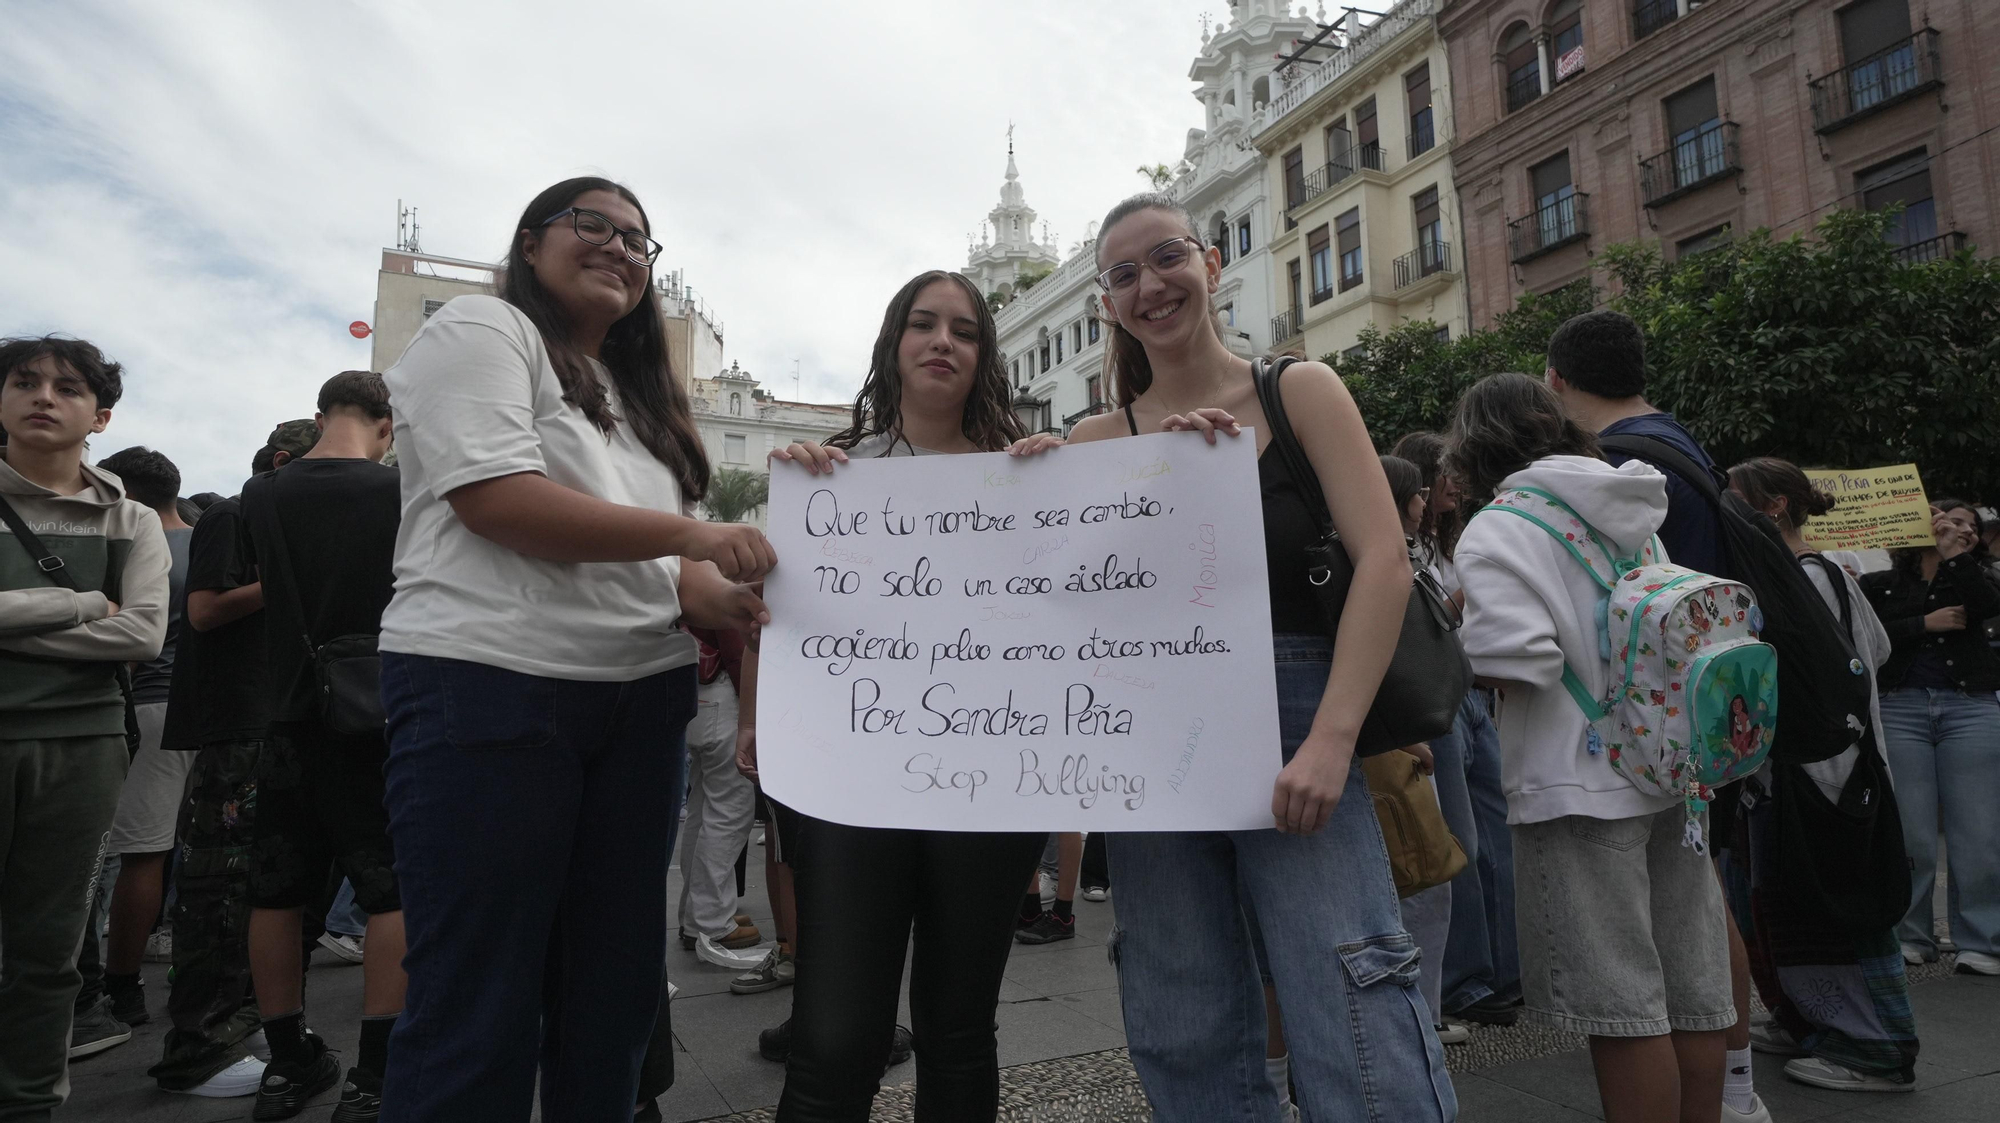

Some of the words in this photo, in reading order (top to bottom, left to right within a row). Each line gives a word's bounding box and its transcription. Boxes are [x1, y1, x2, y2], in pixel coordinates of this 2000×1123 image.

[983, 468, 1022, 489] KIRA
[1811, 477, 1837, 491] DRA
[1874, 477, 1886, 485] ES
[1887, 475, 1903, 484] UNA
[1904, 473, 1915, 481] DE
[1876, 490, 1889, 499] DE
[1, 520, 56, 532] Clvin
[59, 520, 97, 534] Klein
[806, 489, 868, 537] Que
[881, 497, 915, 535] tu
[925, 500, 1016, 536] nombre
[1033, 509, 1069, 529] sea
[1080, 492, 1174, 524] cambio,
[814, 566, 860, 594] no
[880, 556, 942, 597] solo
[964, 579, 997, 597] un
[1005, 576, 1052, 595] caso
[1065, 554, 1157, 592] aislado
[1189, 523, 1217, 608] Monica
[801, 622, 919, 676] cogiendo
[930, 628, 991, 675] polvo
[1003, 644, 1065, 660] como
[1078, 628, 1144, 660] otros
[1150, 625, 1230, 657] muchos.
[851, 678, 907, 734] Por
[918, 683, 1048, 737] Sandra
[1065, 684, 1132, 736] Peña
[903, 753, 988, 802] Stop
[1015, 749, 1145, 811] Bullying
[91, 830, 110, 875] Calvin
[86, 875, 99, 910] Klein
